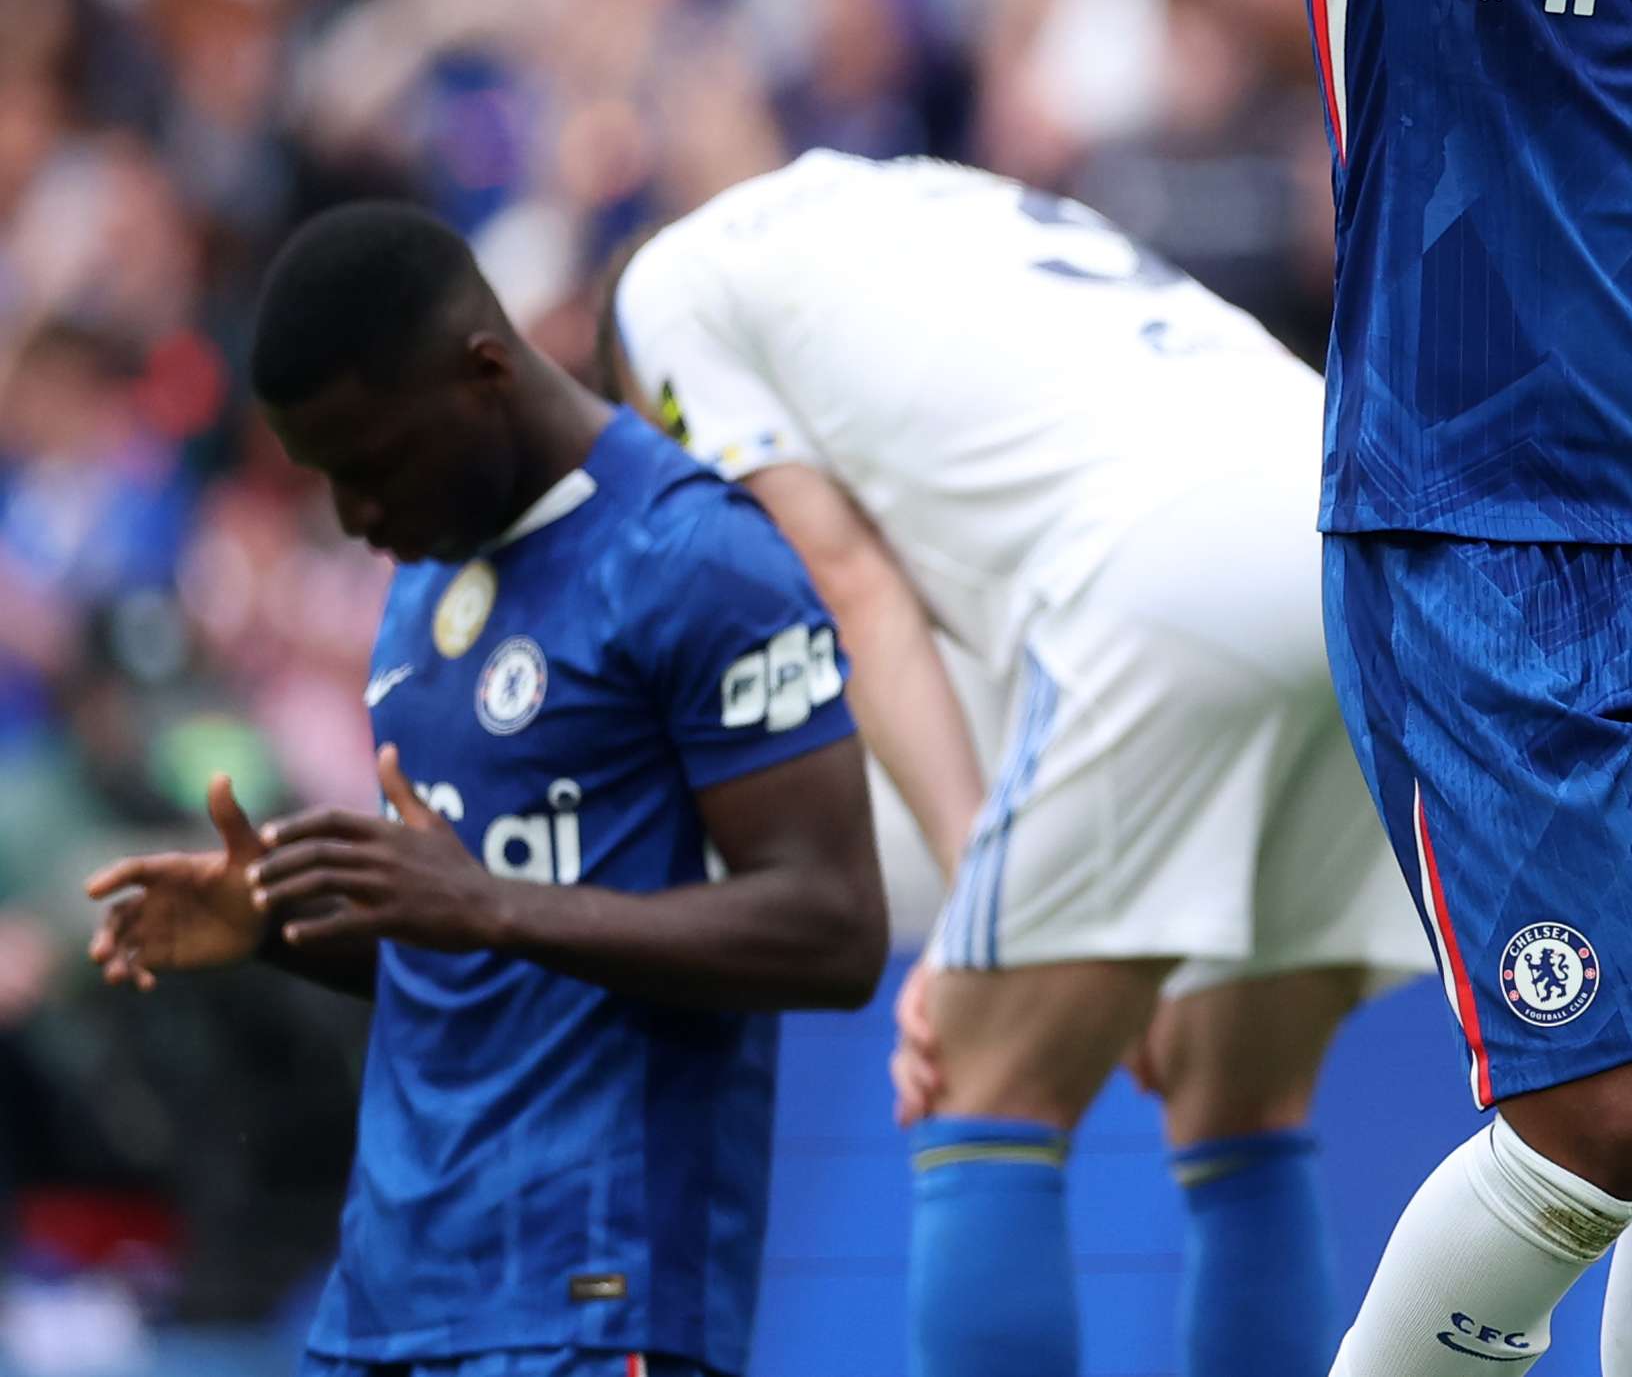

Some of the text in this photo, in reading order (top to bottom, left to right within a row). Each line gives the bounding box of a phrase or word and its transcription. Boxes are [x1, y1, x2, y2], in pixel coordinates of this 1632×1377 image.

[1508, 926, 1570, 958] CHELSEA
[1523, 990, 1589, 1021] FOOTBALL CLUB
[1450, 1311, 1530, 1349] CFC
